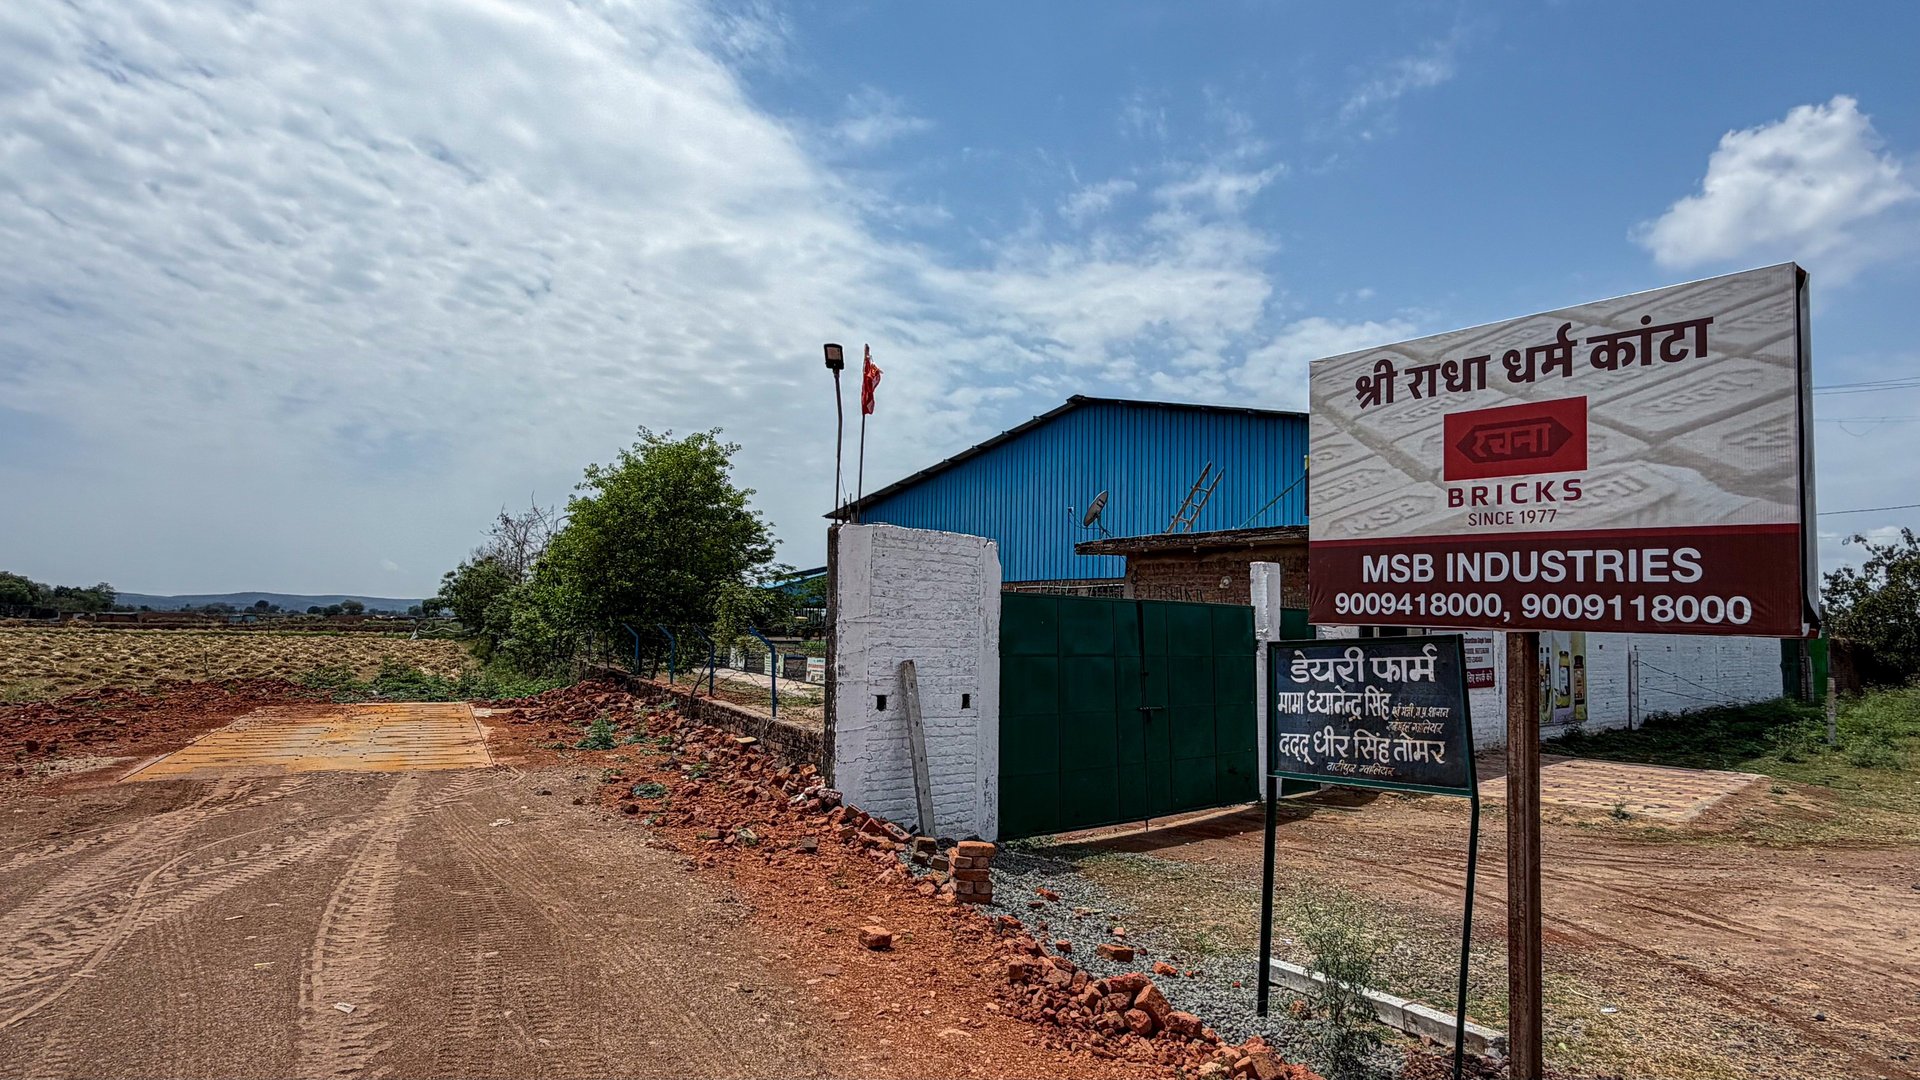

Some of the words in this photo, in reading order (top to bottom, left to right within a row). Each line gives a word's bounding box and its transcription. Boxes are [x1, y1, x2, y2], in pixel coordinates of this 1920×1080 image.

[1355, 359, 1398, 408] श्री
[1405, 355, 1490, 400] राधा
[1502, 322, 1577, 383] धर्म
[1586, 314, 1714, 371] कांटा
[1471, 422, 1552, 456] रचना
[1448, 479, 1582, 508] BRICKS
[1468, 511, 1514, 526] SINCE
[1519, 509, 1557, 524] 1977
[1363, 554, 1434, 584] MSB
[1446, 548, 1703, 584] INDUSTRIES
[1335, 592, 1511, 623] 9009418000,
[1522, 593, 1752, 625] 9009118000
[1291, 646, 1364, 683] डेयरी
[1370, 643, 1437, 683] फार्म
[1278, 692, 1304, 715] मामा
[1307, 685, 1364, 722] ध्यानेन्द्र
[1364, 685, 1391, 720] सिंह
[1313, 725, 1350, 758] धीर
[1353, 728, 1391, 763] सिंह
[1394, 731, 1446, 764] तोमर
